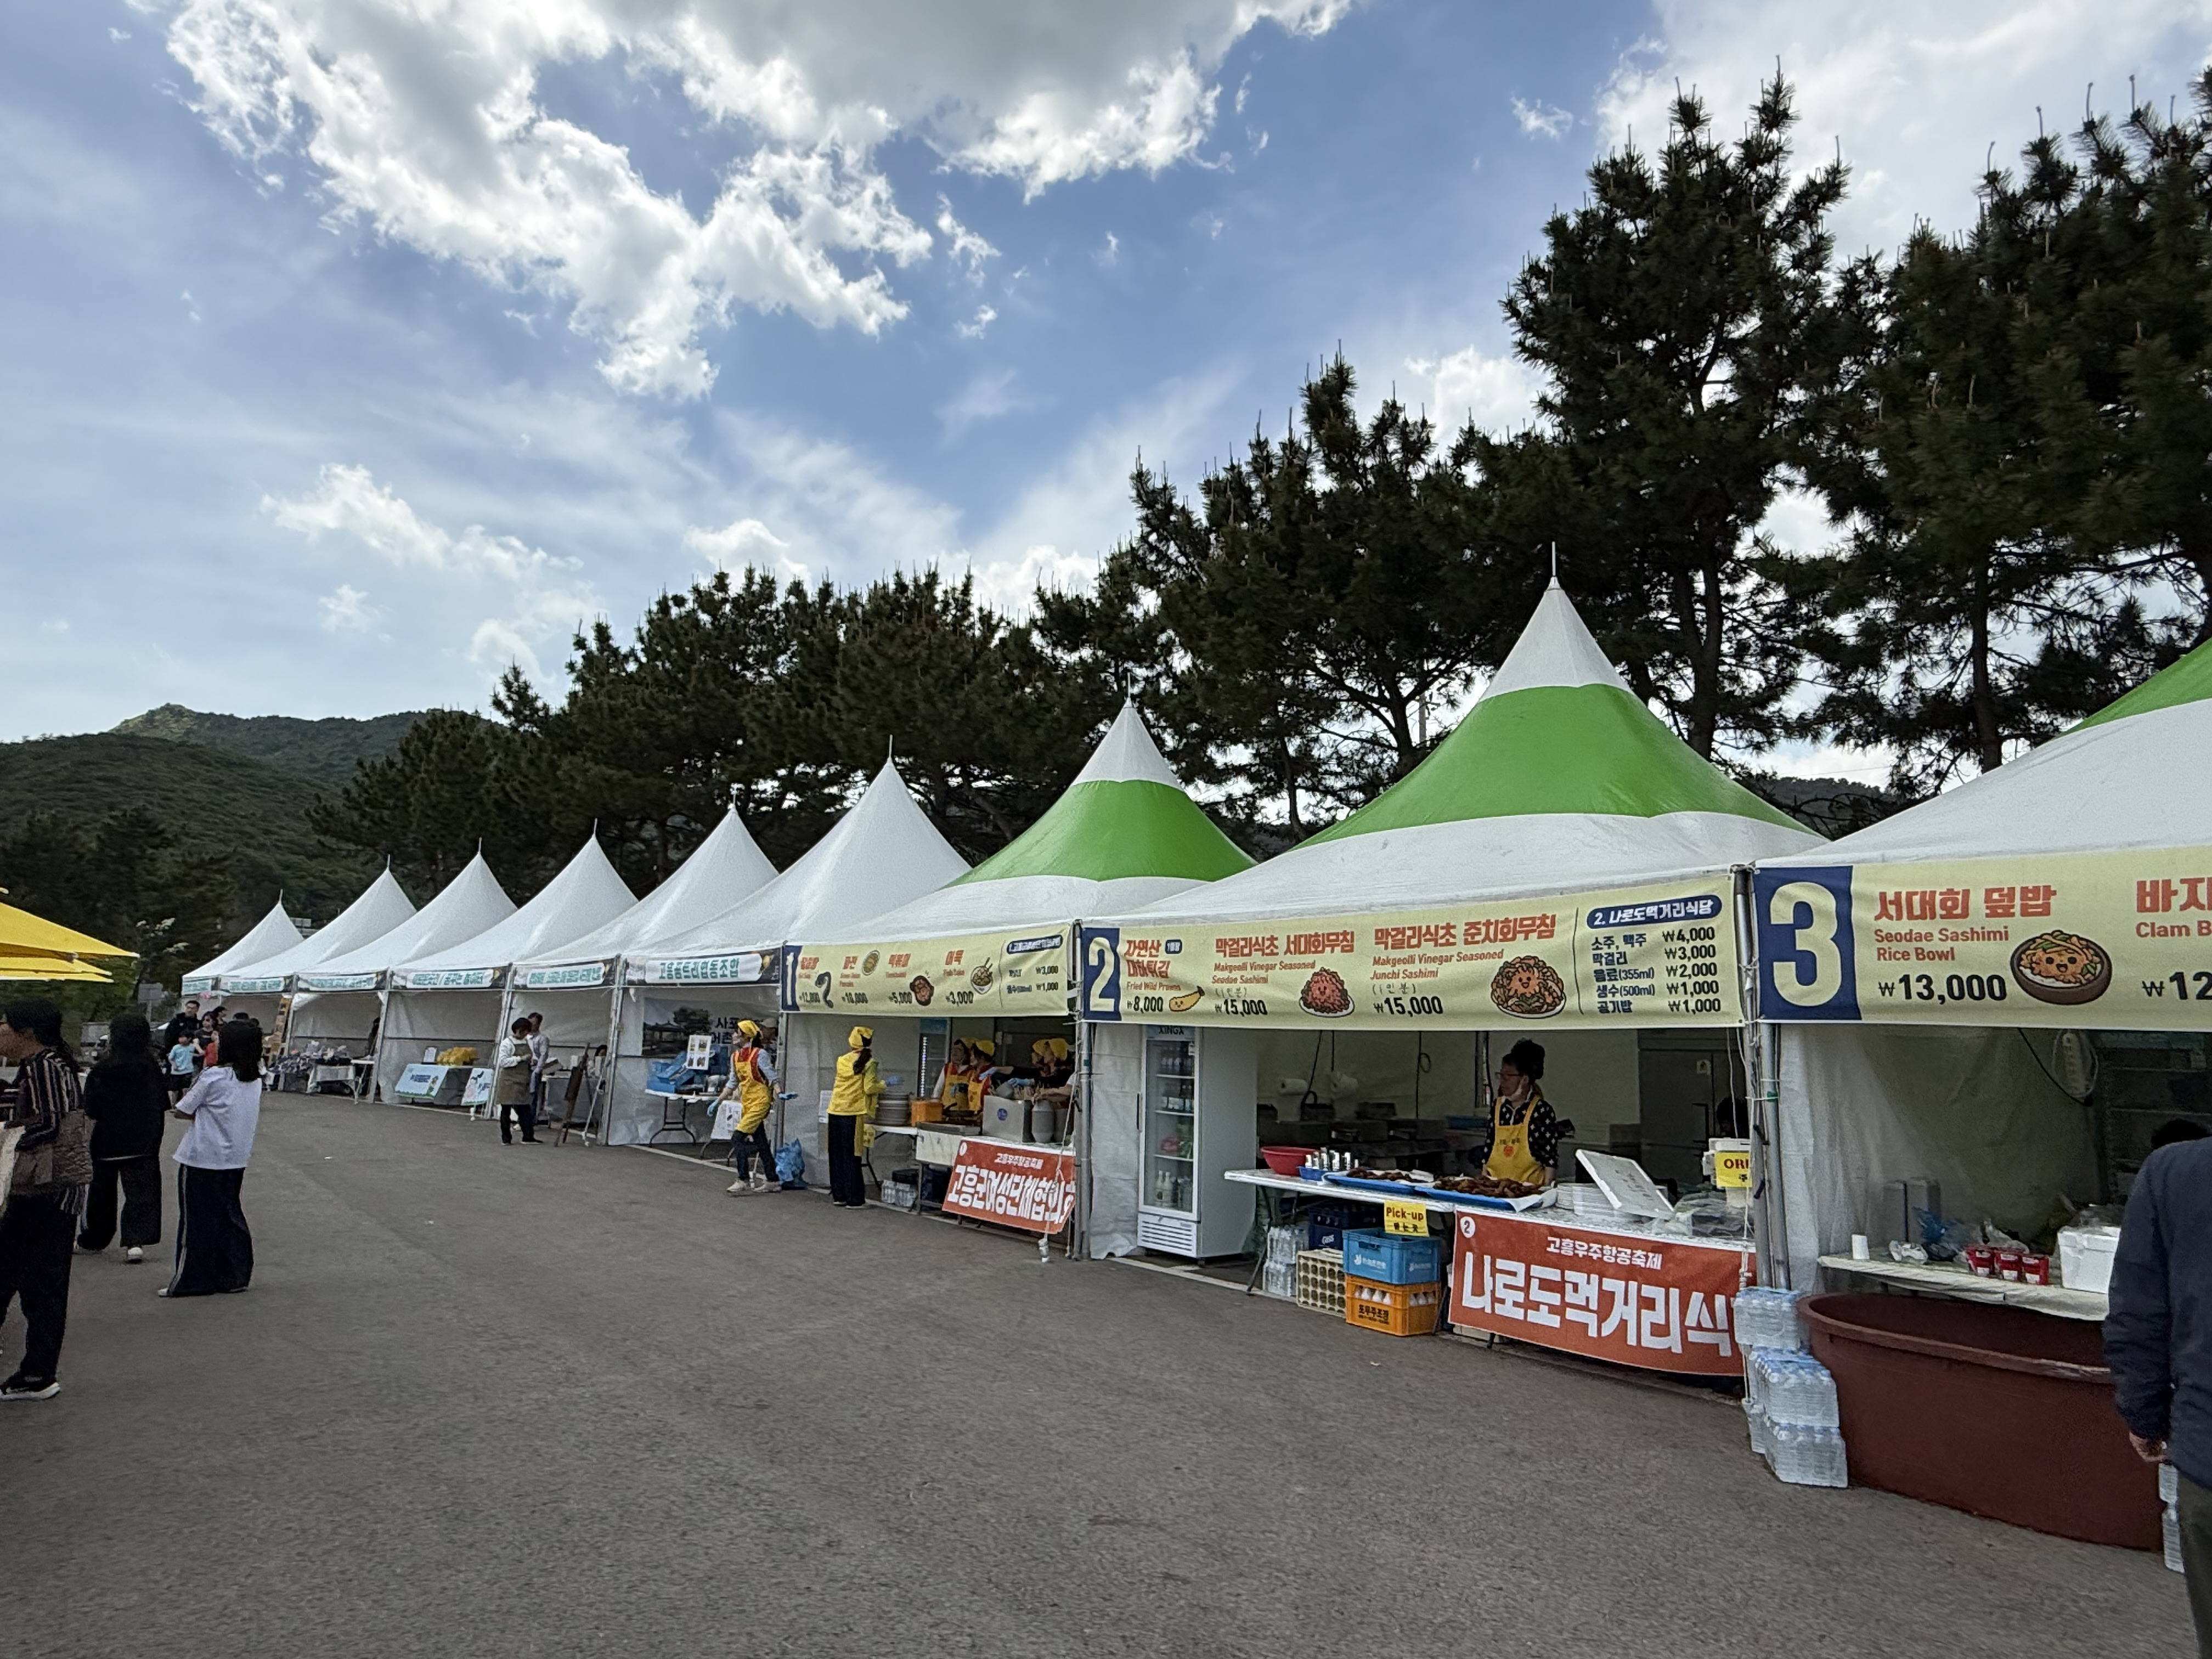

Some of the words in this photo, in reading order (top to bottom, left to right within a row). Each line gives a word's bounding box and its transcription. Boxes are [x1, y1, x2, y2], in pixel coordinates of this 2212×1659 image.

[1874, 888, 1970, 921] 서대회
[1984, 885, 2057, 917] 덮밥
[2137, 877, 2212, 913] 바지
[1609, 899, 1714, 924] 나로도먹거리식당
[1374, 922, 1457, 950] 막걸리식초
[1463, 913, 1556, 946] 준치회무침
[1662, 927, 1715, 944] ₩4,000
[1874, 929, 1934, 943] Seodae
[1938, 926, 2009, 941] Sashimi
[2136, 922, 2191, 938] Clam
[1126, 939, 1161, 958] 자연산
[1215, 935, 1279, 958] 막걸리식초
[1284, 930, 1355, 955] 서대회무침
[1592, 936, 1620, 951] 소주,
[1623, 933, 1646, 947] 맥주
[1770, 882, 1842, 1006] 3
[1372, 955, 1415, 968] Makgeolli
[1418, 953, 1454, 966] Vinegar
[1456, 948, 1504, 962] Seasoned
[1592, 951, 1628, 966] 막걸리
[1664, 944, 1716, 962] ₩3,000
[1877, 947, 1911, 961] Rice
[1914, 947, 1955, 961] Bowl
[1089, 937, 1115, 1011] 2
[1126, 960, 1170, 979] 대하튀김
[1250, 961, 1277, 972] Vinegar
[1279, 959, 1316, 970] Seasoned
[1370, 968, 1400, 980] Junchi
[1402, 967, 1439, 978] Sashimi
[1666, 962, 1717, 979] ₩2,000
[786, 952, 794, 1005] 1
[1596, 984, 1655, 998] 생수(500ml)
[1666, 980, 1719, 997] ₩1,000
[1878, 974, 2007, 1005] ₩13,000
[1373, 995, 1443, 1017] ₩15,000
[1597, 1000, 1633, 1014] 공기밥
[1668, 998, 1721, 1015] ₩1,000
[1724, 1159, 1748, 1169] OR
[1386, 1207, 1424, 1222] Pick-up
[1464, 1220, 1471, 1234] 2
[1547, 1236, 1662, 1270] 고흥우주항공축제
[1462, 1251, 1734, 1356] 나로도먹거리식
